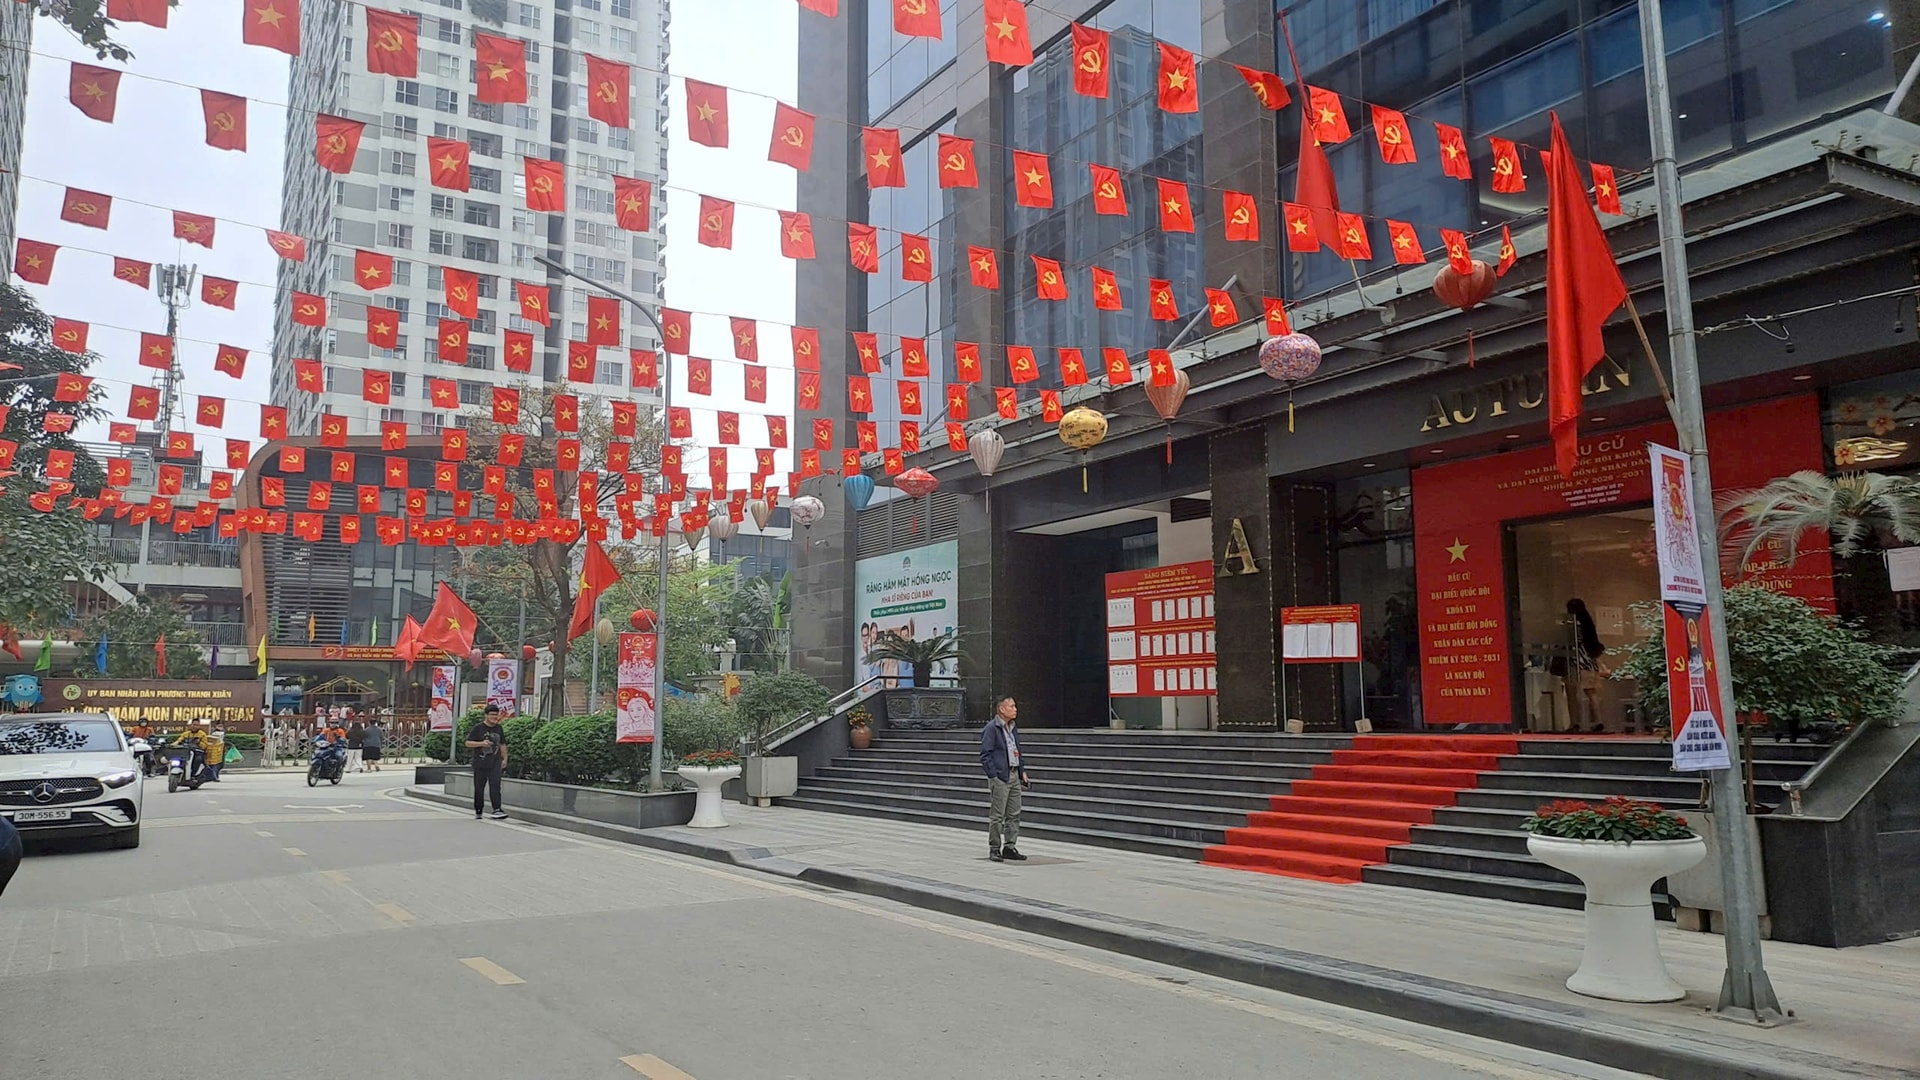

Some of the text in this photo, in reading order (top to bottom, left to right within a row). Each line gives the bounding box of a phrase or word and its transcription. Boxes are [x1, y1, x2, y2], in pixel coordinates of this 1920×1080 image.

[1420, 354, 1631, 432] AUTUN
[1592, 474, 1614, 483] 2026
[1216, 518, 1261, 577] A
[866, 582, 882, 593] RĂNG
[884, 578, 896, 590] HÀM
[898, 576, 910, 590] MẶT
[932, 570, 952, 584] NGỌC
[1465, 605, 1476, 613] XVI
[1466, 636, 1479, 646] CÁC
[1460, 654, 1477, 662] 2026
[1484, 654, 1500, 662] 2031
[1455, 670, 1471, 680] NGÀY
[100, 690, 115, 698] BAN
[118, 689, 138, 698] NHÂN
[140, 689, 155, 698] DÂN
[157, 689, 186, 698] PHƯỜNG
[188, 690, 211, 698] THANH
[212, 689, 232, 698] XUÂN
[1454, 686, 1471, 696] TOÀN
[144, 706, 170, 721] NON
